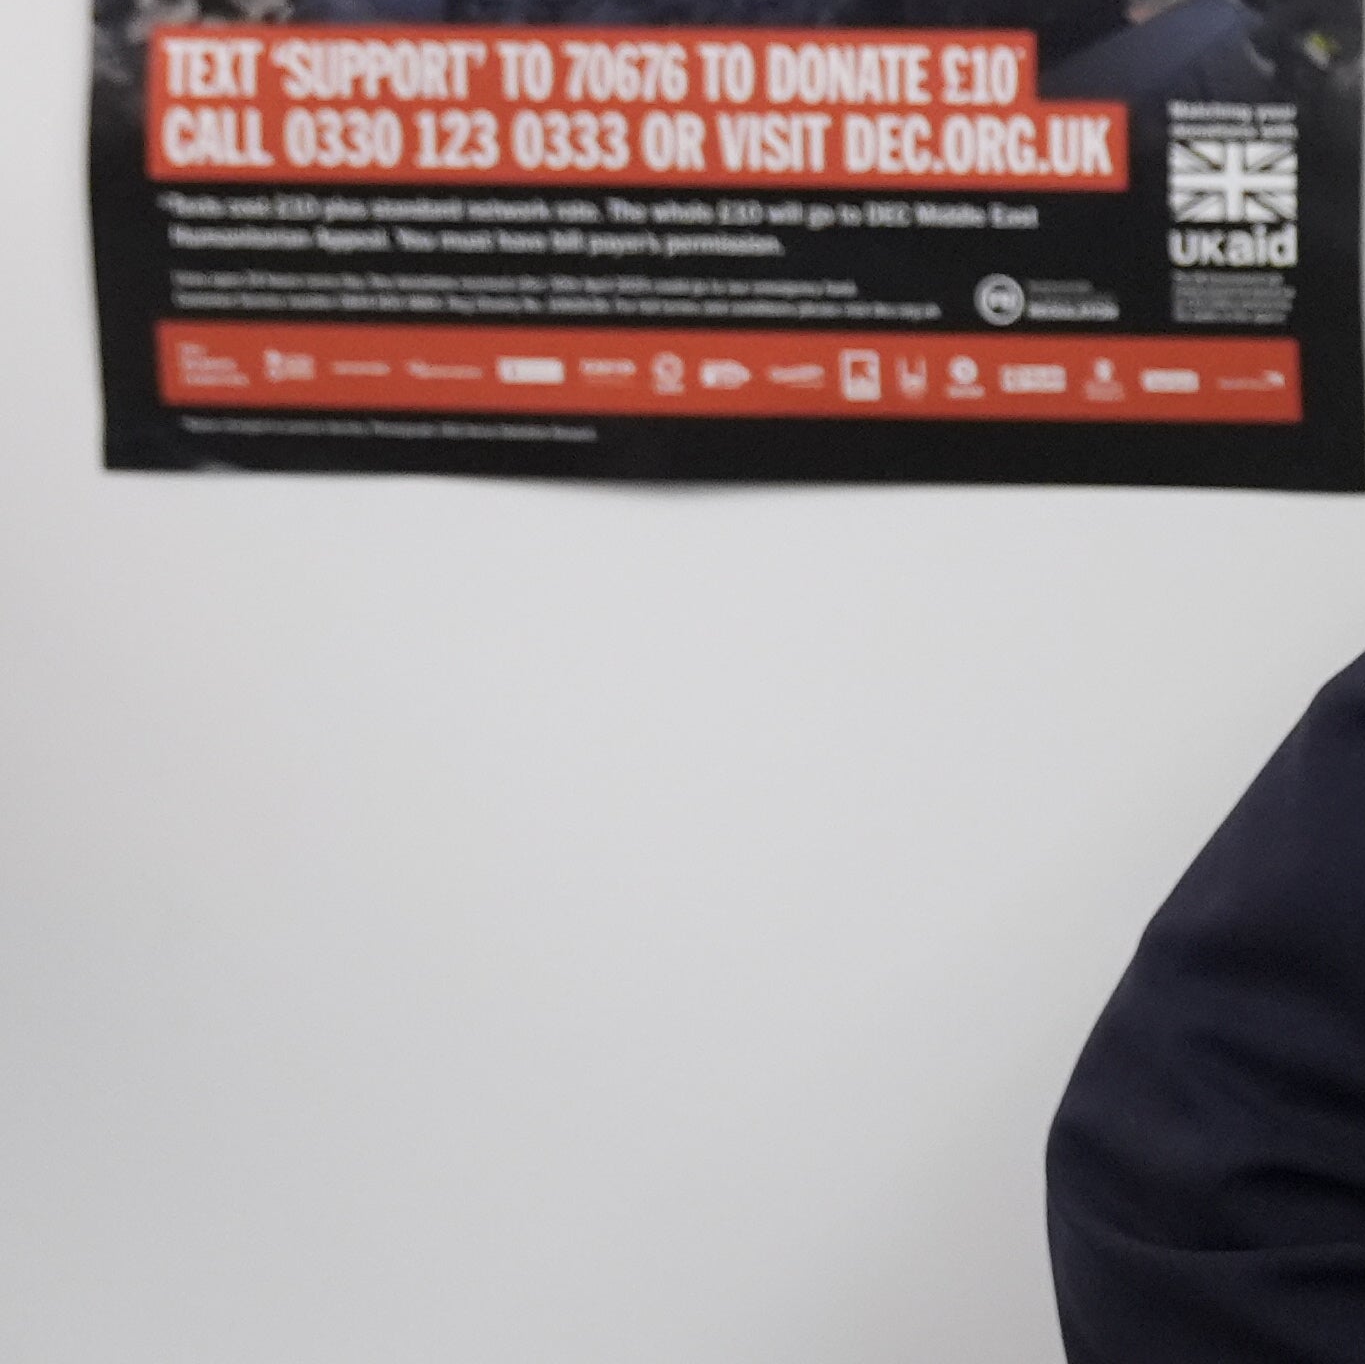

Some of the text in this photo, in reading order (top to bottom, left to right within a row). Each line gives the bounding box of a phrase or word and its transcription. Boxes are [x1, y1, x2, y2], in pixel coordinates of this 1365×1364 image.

[162, 41, 263, 99] TEXT
[271, 42, 487, 101] 'SUPPORT'
[497, 44, 555, 102] TO
[562, 44, 689, 102] 70676
[701, 44, 755, 104] TO
[765, 44, 932, 105] DONATE
[161, 107, 1114, 176] CALL 0330 123 0333 OR VISIT DEC.ORG.UK
